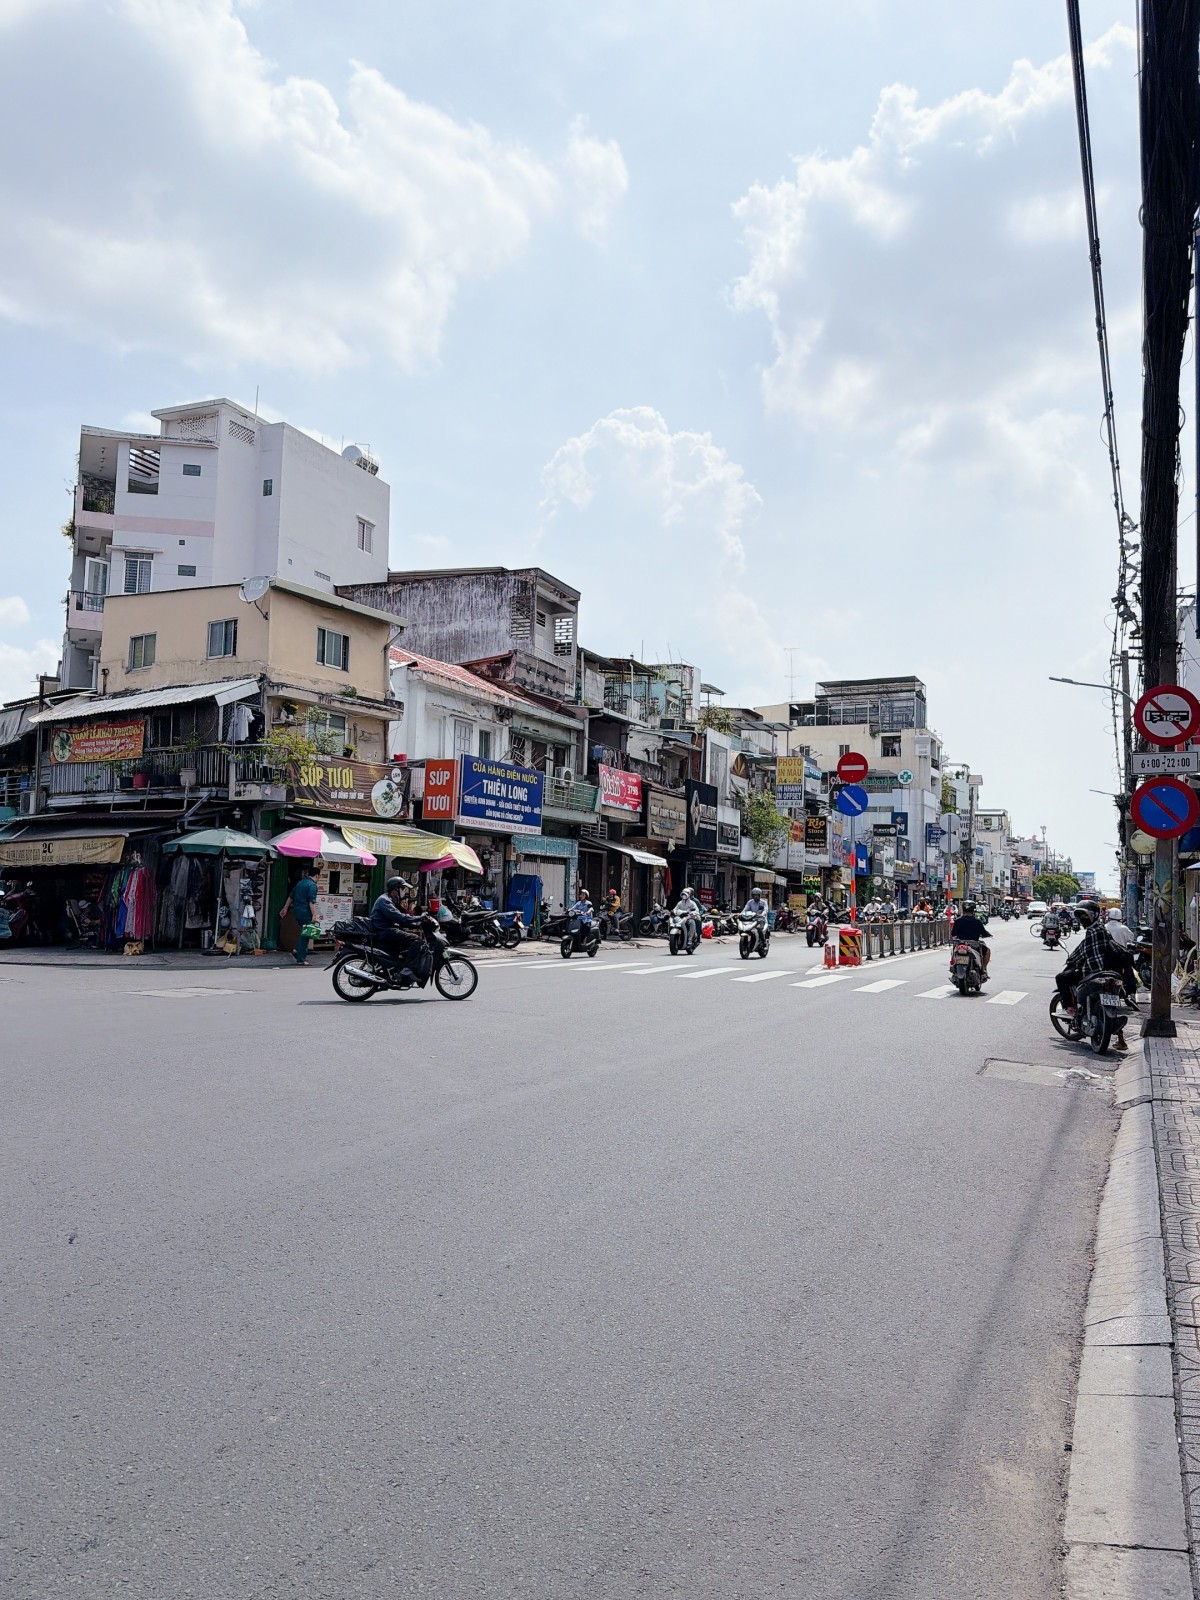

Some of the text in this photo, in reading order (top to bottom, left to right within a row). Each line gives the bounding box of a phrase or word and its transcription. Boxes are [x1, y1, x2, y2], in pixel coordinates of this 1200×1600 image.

[778, 758, 802, 767] PHOTO
[326, 767, 354, 789] TƯƠI
[429, 768, 450, 786] SÚP
[487, 765, 506, 778] HÀNG
[506, 770, 521, 782] ĐIỆN
[522, 773, 538, 785] NƯỚC
[778, 769, 785, 777] IN
[482, 778, 528, 802] THIÊN LONG
[427, 795, 450, 811] TƯƠI
[807, 817, 826, 829] Rio
[42, 842, 54, 854] 2C
